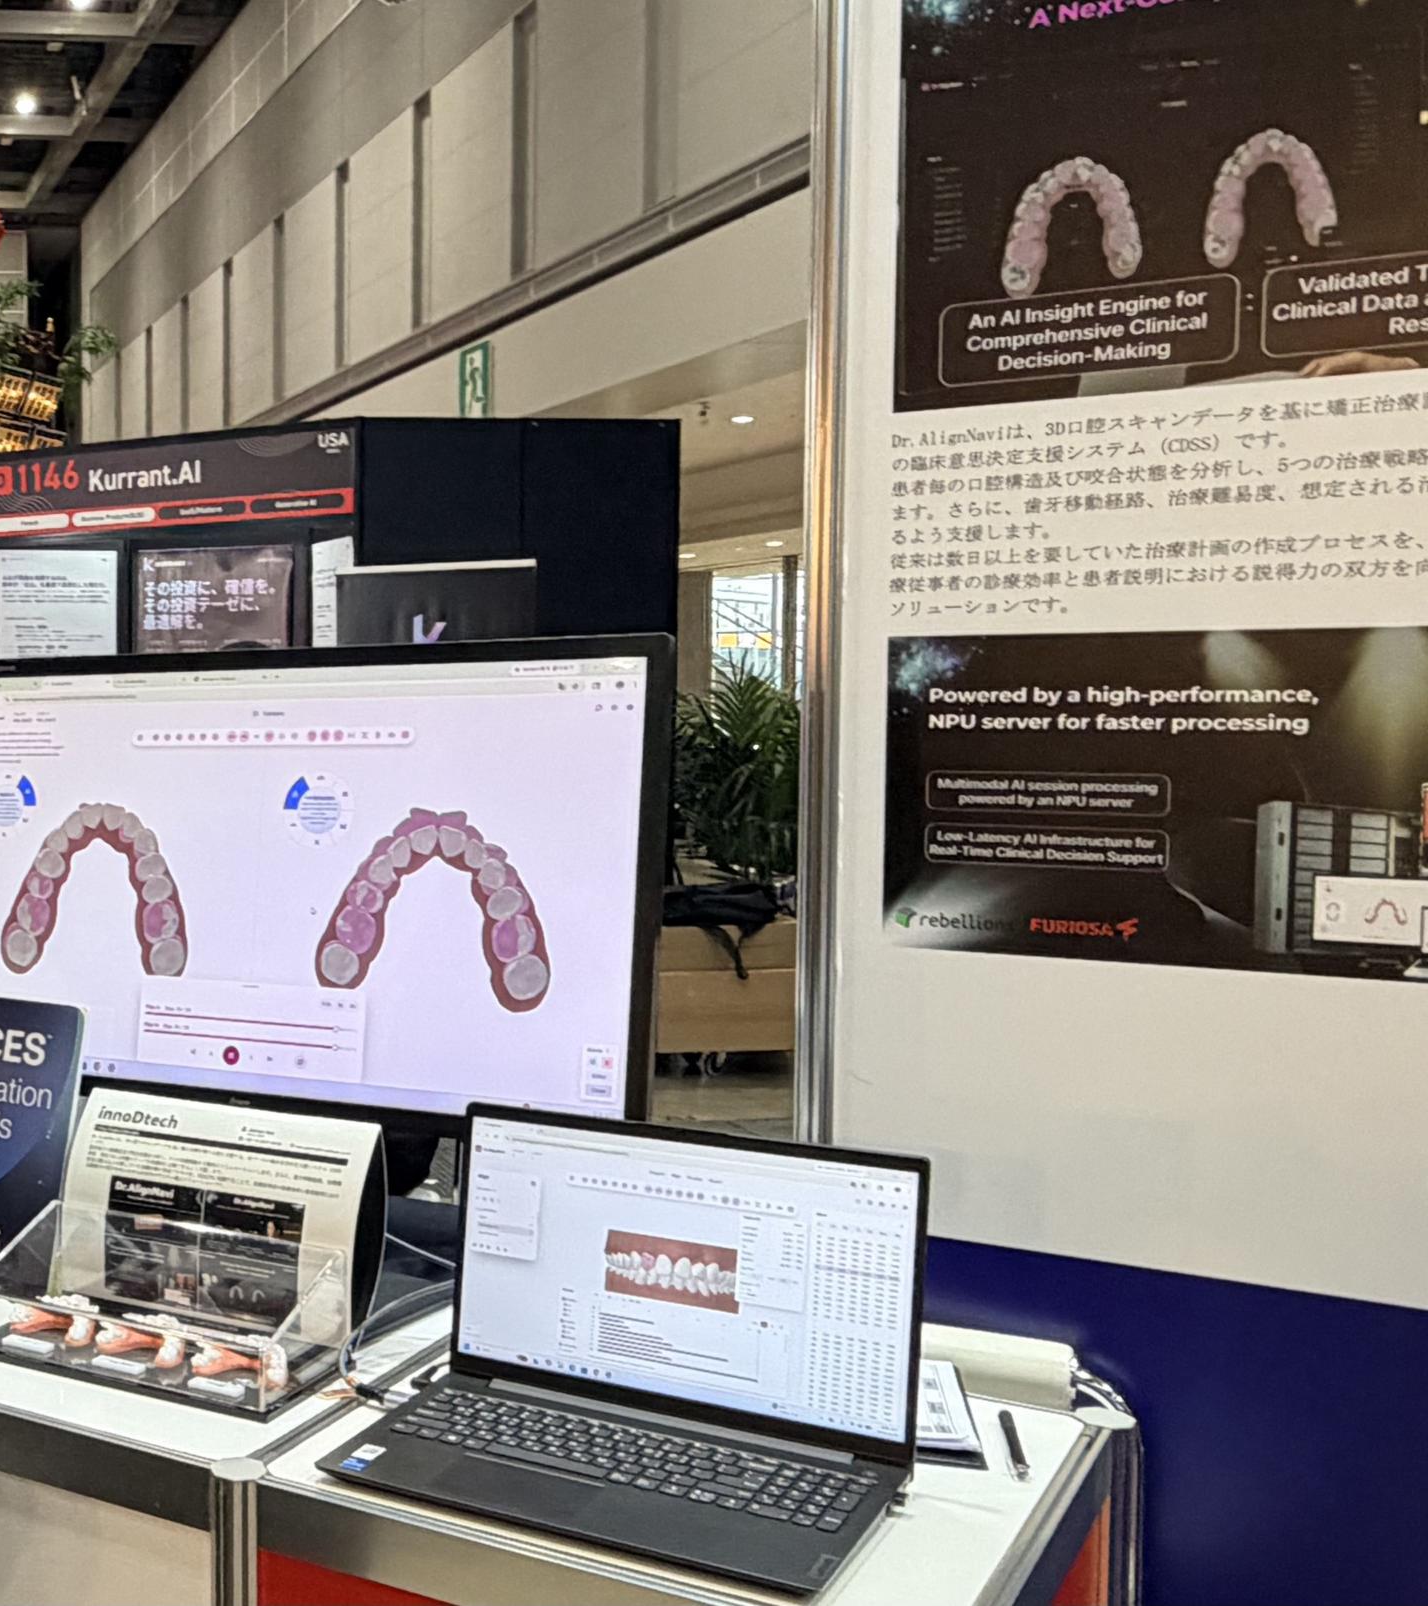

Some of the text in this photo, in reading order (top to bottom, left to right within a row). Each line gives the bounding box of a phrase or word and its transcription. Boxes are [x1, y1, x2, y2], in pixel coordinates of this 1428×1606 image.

[1028, 8, 1052, 29] A
[1297, 265, 1410, 295] Validated
[968, 289, 1208, 331] An AI Insight Engine for
[1272, 293, 1419, 322] Clinical Data
[966, 312, 1208, 353] Comprehensive Clinical
[997, 342, 1172, 372] Decision-Making
[317, 432, 350, 448] USA
[88, 459, 202, 493] Kurrant.AI
[892, 521, 1050, 545] るよう支援します。
[890, 596, 1069, 617] ソリューションです。
[928, 684, 1320, 707] Powered by a high-performance,
[927, 712, 1310, 736] NPU server for faster processing
[937, 778, 1159, 796] Multimodal AI session processing
[958, 794, 1134, 808] powered by an NPU server
[936, 830, 1157, 849] Low-Latency AI Infrastructure for
[929, 844, 1164, 866] Real-Time Clinical Decision Support
[1029, 917, 1114, 937] FURIOSA
[97, 1106, 179, 1129] innoDtech
